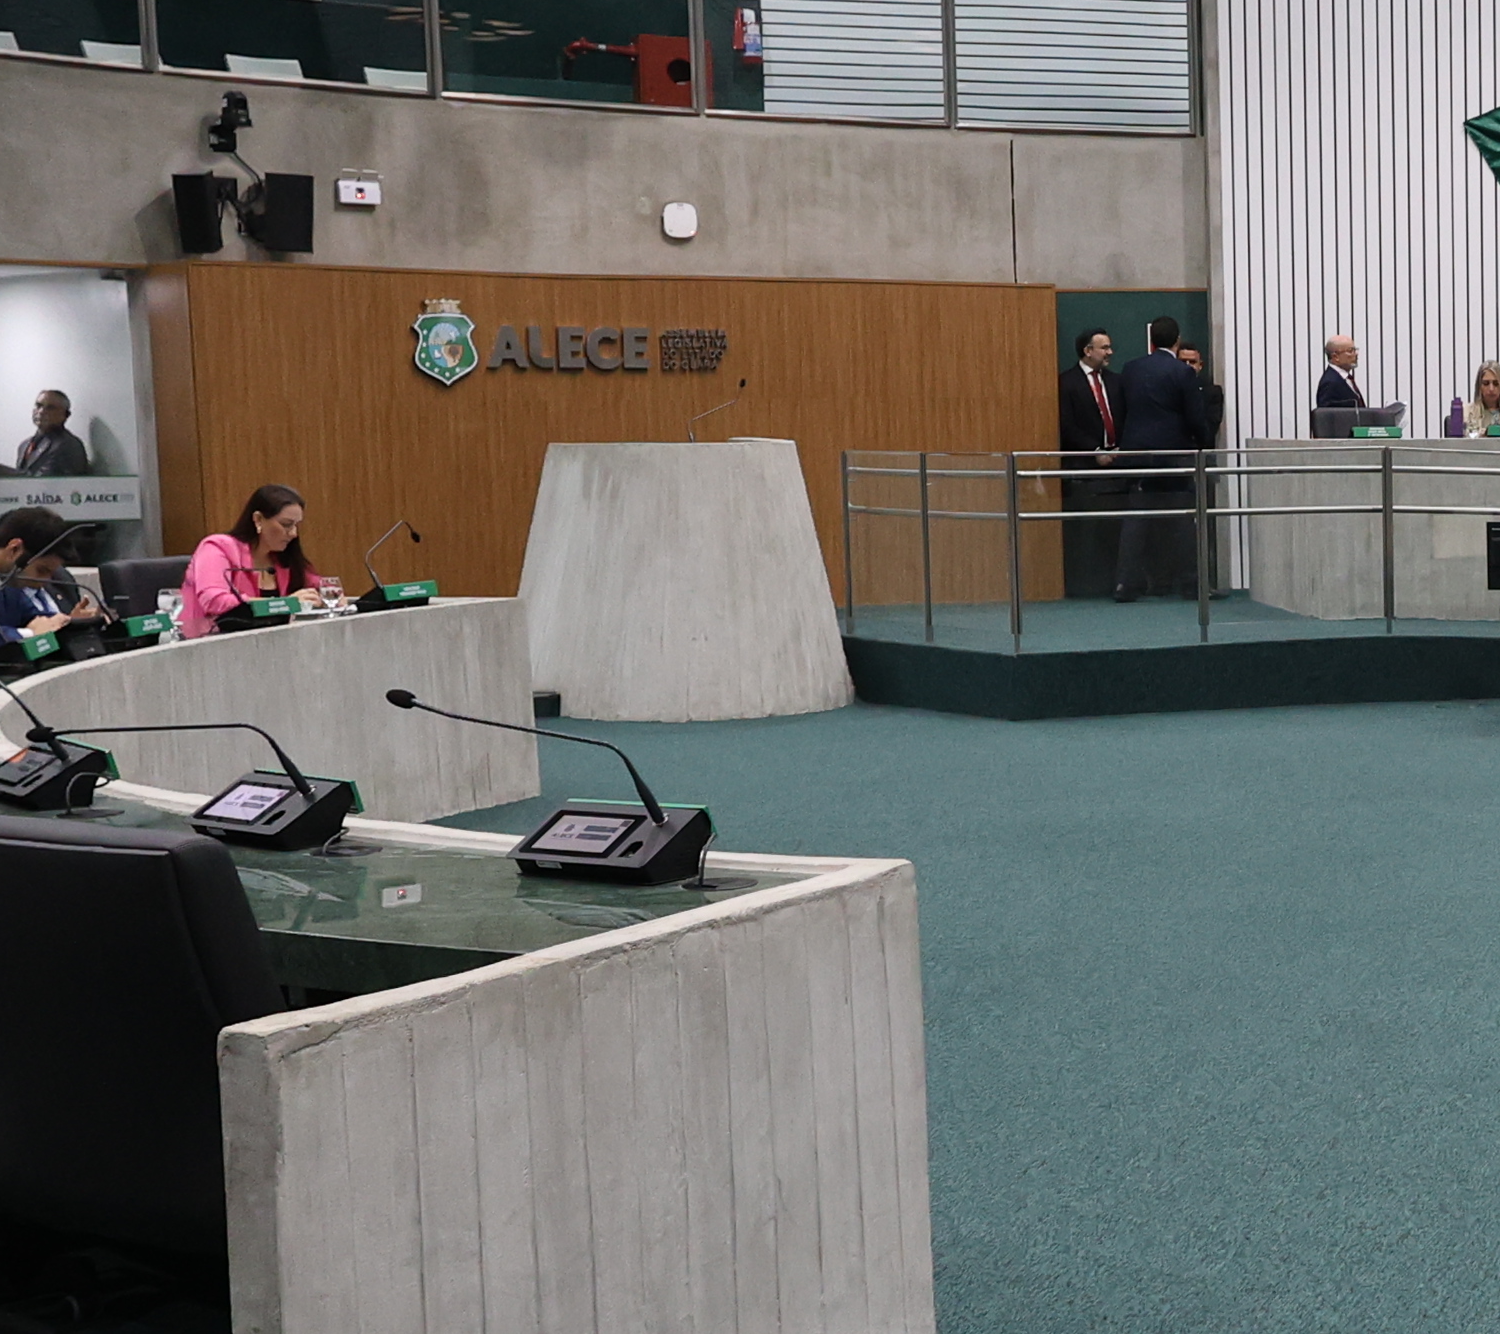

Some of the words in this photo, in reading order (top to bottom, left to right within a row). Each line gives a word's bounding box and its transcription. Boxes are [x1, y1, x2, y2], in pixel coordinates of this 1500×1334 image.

[488, 325, 649, 369] ALECE
[26, 492, 63, 505] SAÍDA
[85, 493, 119, 503] ALECE
